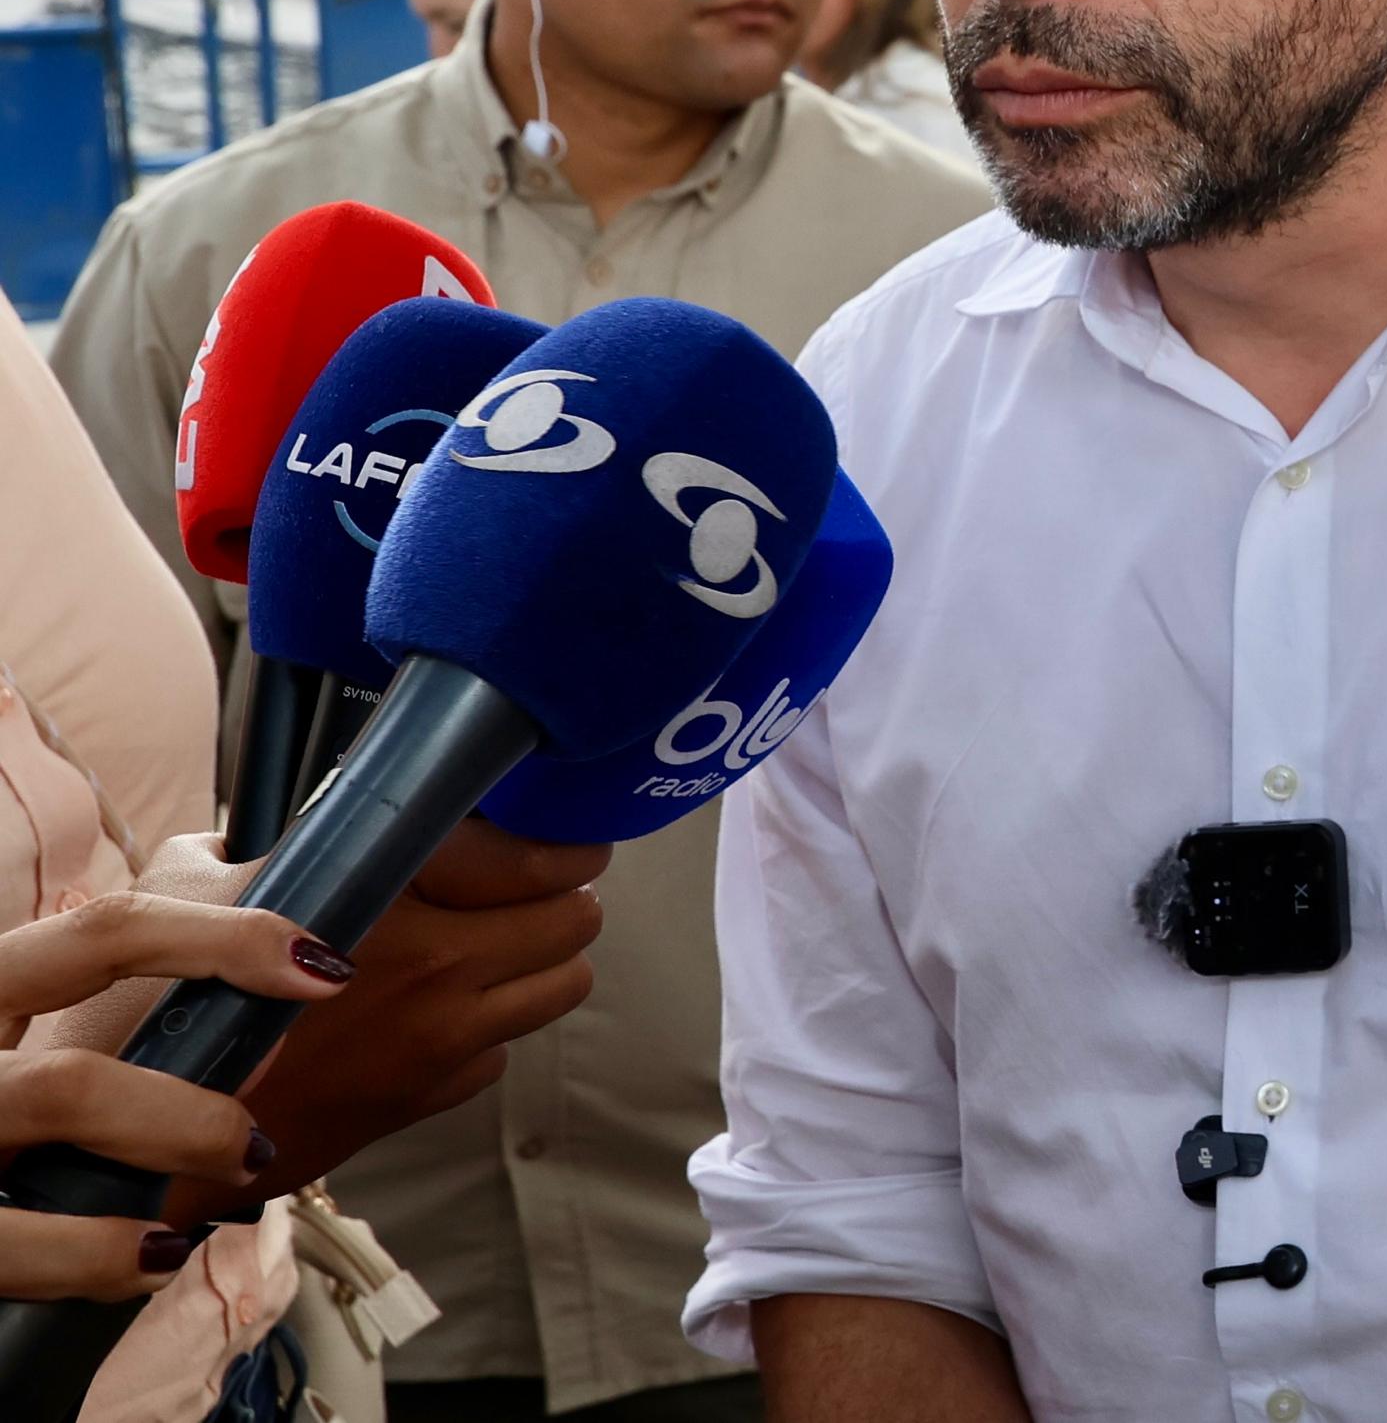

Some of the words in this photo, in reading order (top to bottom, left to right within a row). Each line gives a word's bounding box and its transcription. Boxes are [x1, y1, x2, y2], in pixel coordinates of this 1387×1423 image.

[342, 686, 381, 704] SV100
[633, 772, 726, 797] radio
[1294, 883, 1309, 914] TX
